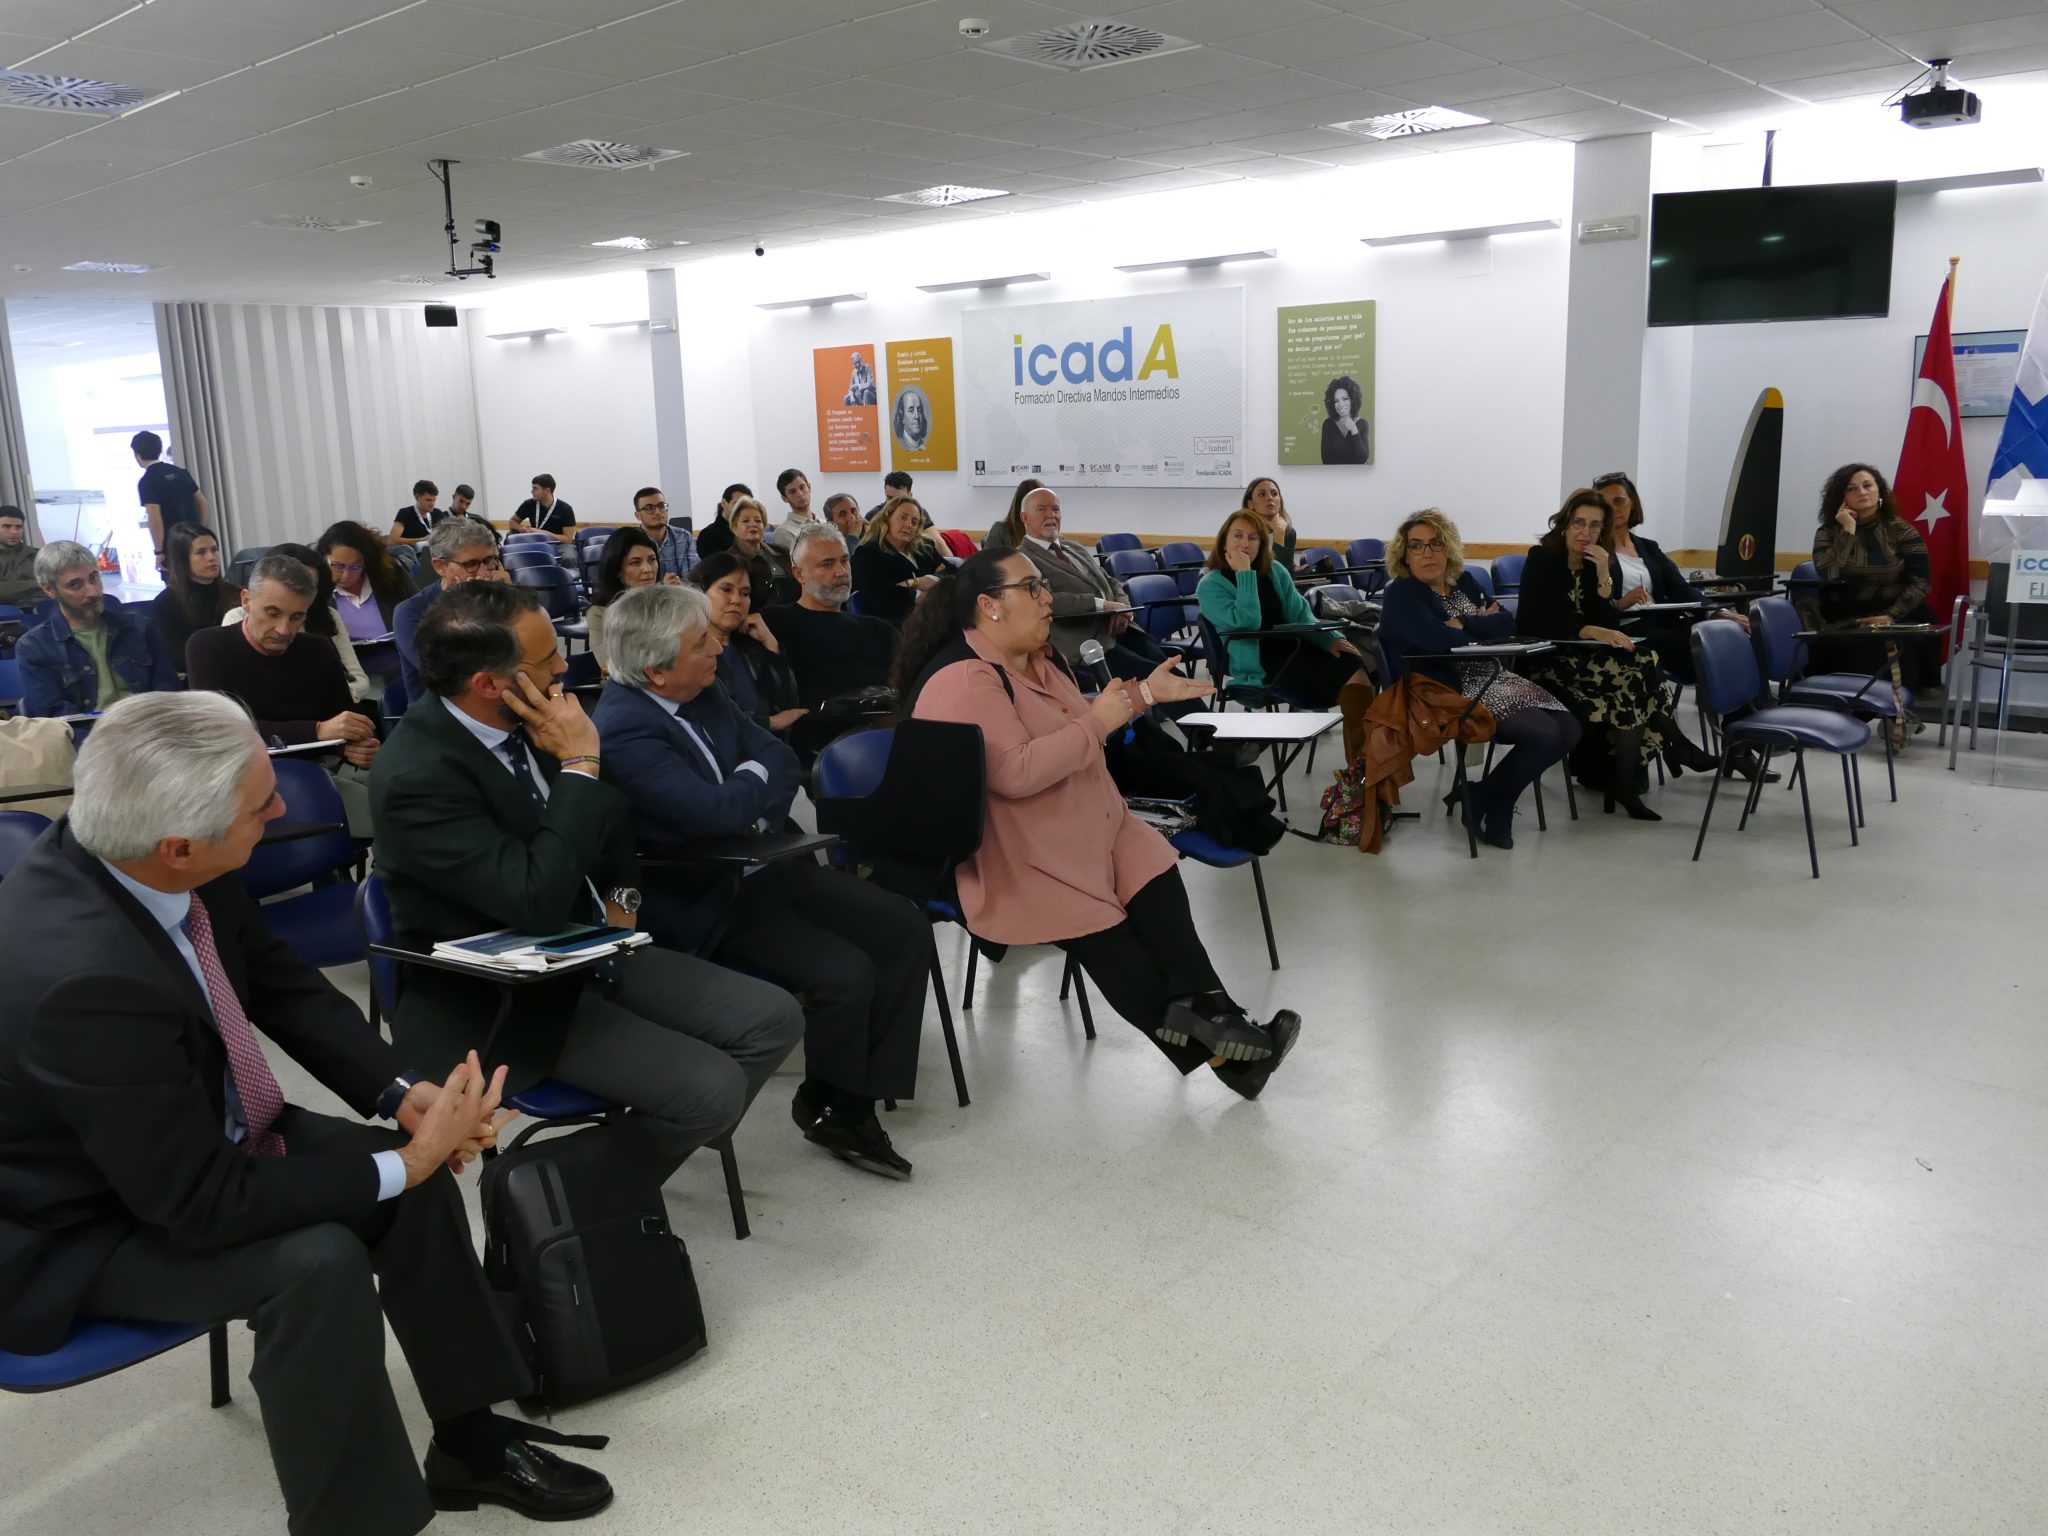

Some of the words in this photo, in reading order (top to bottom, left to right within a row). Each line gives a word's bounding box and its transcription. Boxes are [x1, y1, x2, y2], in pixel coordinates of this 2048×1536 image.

[1013, 323, 1179, 386] icadA
[1014, 391, 1055, 405] Formación
[1057, 389, 1091, 404] Directiva
[1093, 388, 1127, 402] Mandos
[1129, 386, 1180, 401] Intermedios
[1208, 444, 1228, 452] Isabel
